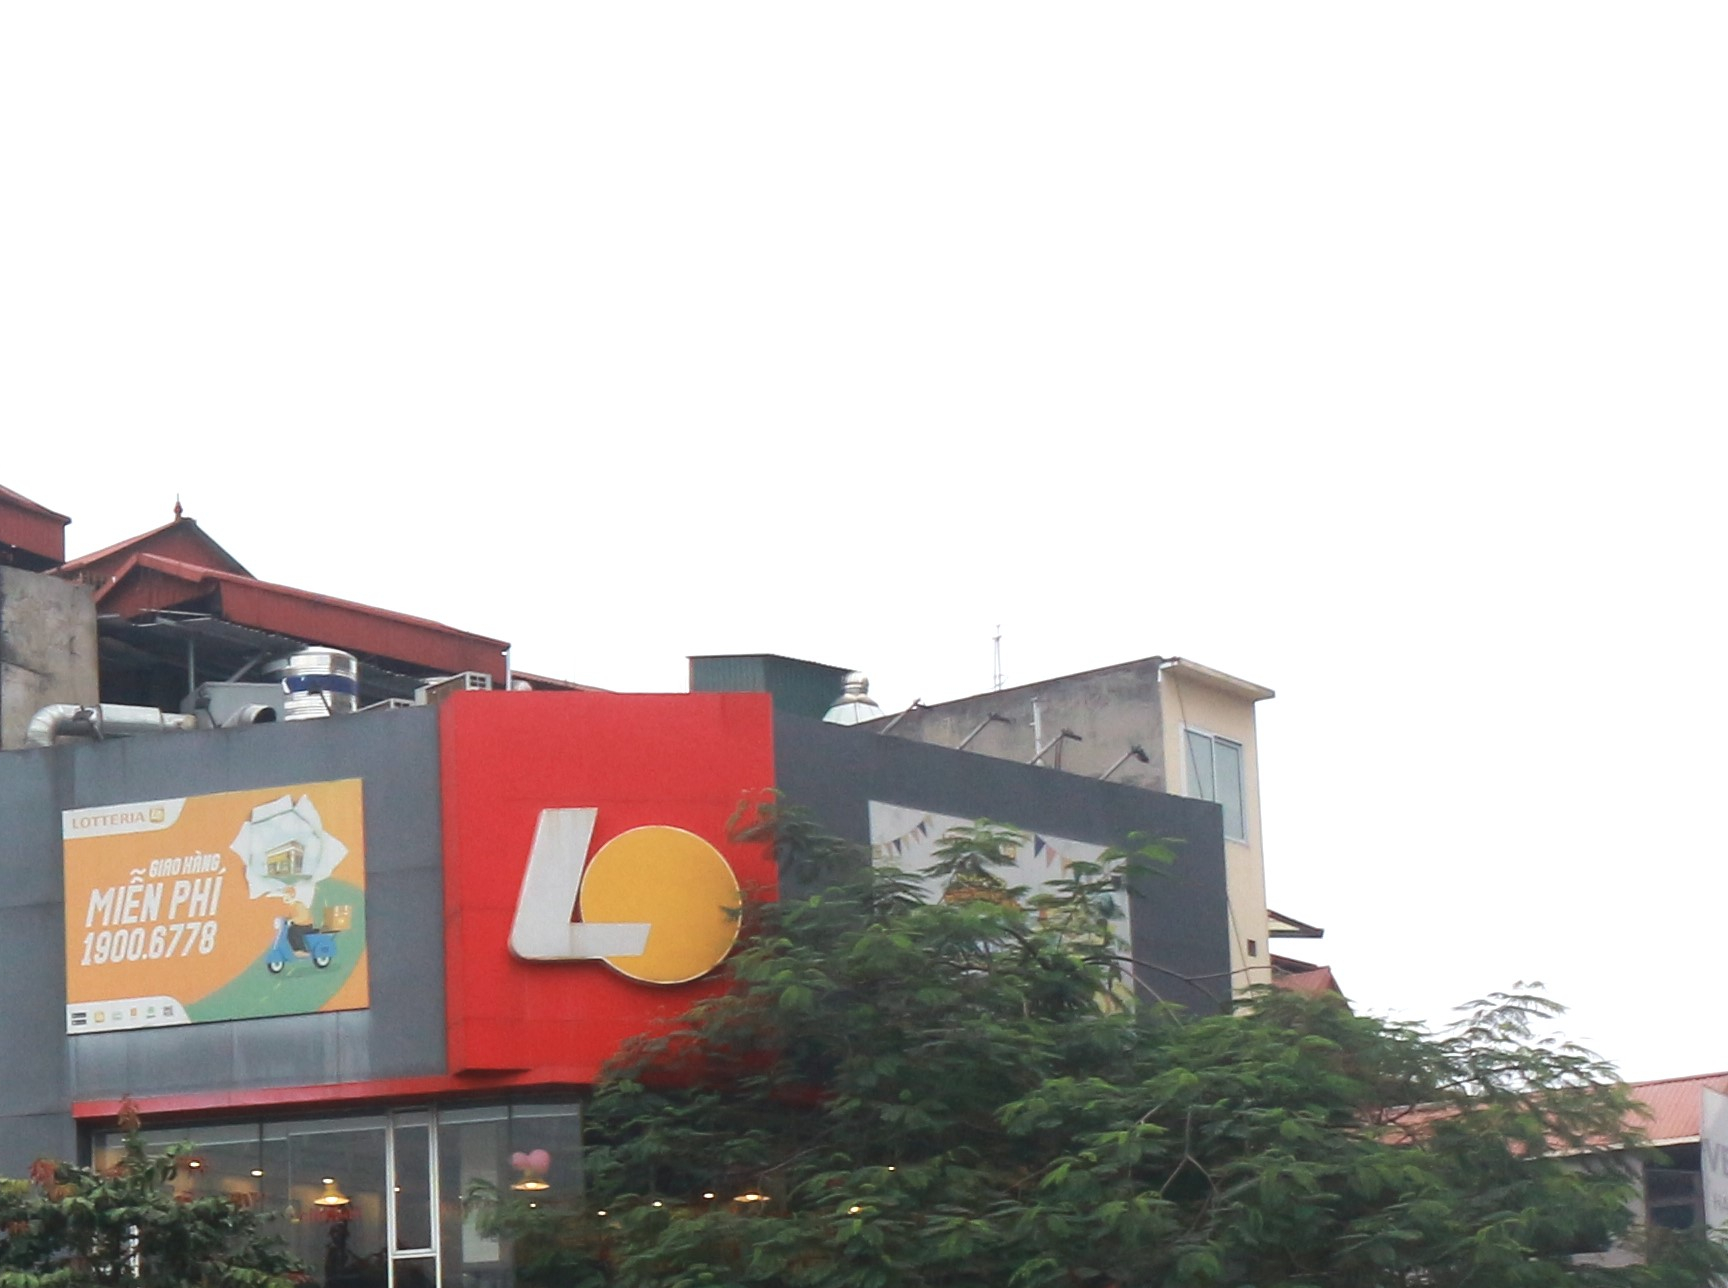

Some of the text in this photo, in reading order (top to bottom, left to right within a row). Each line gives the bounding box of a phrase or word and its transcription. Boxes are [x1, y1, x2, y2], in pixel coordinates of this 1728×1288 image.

[71, 811, 145, 829] LOTTERIA
[149, 850, 221, 879] GIAO HÀNG
[84, 866, 228, 928] MIỄN PHÍ
[80, 919, 219, 966] 1900.6778
